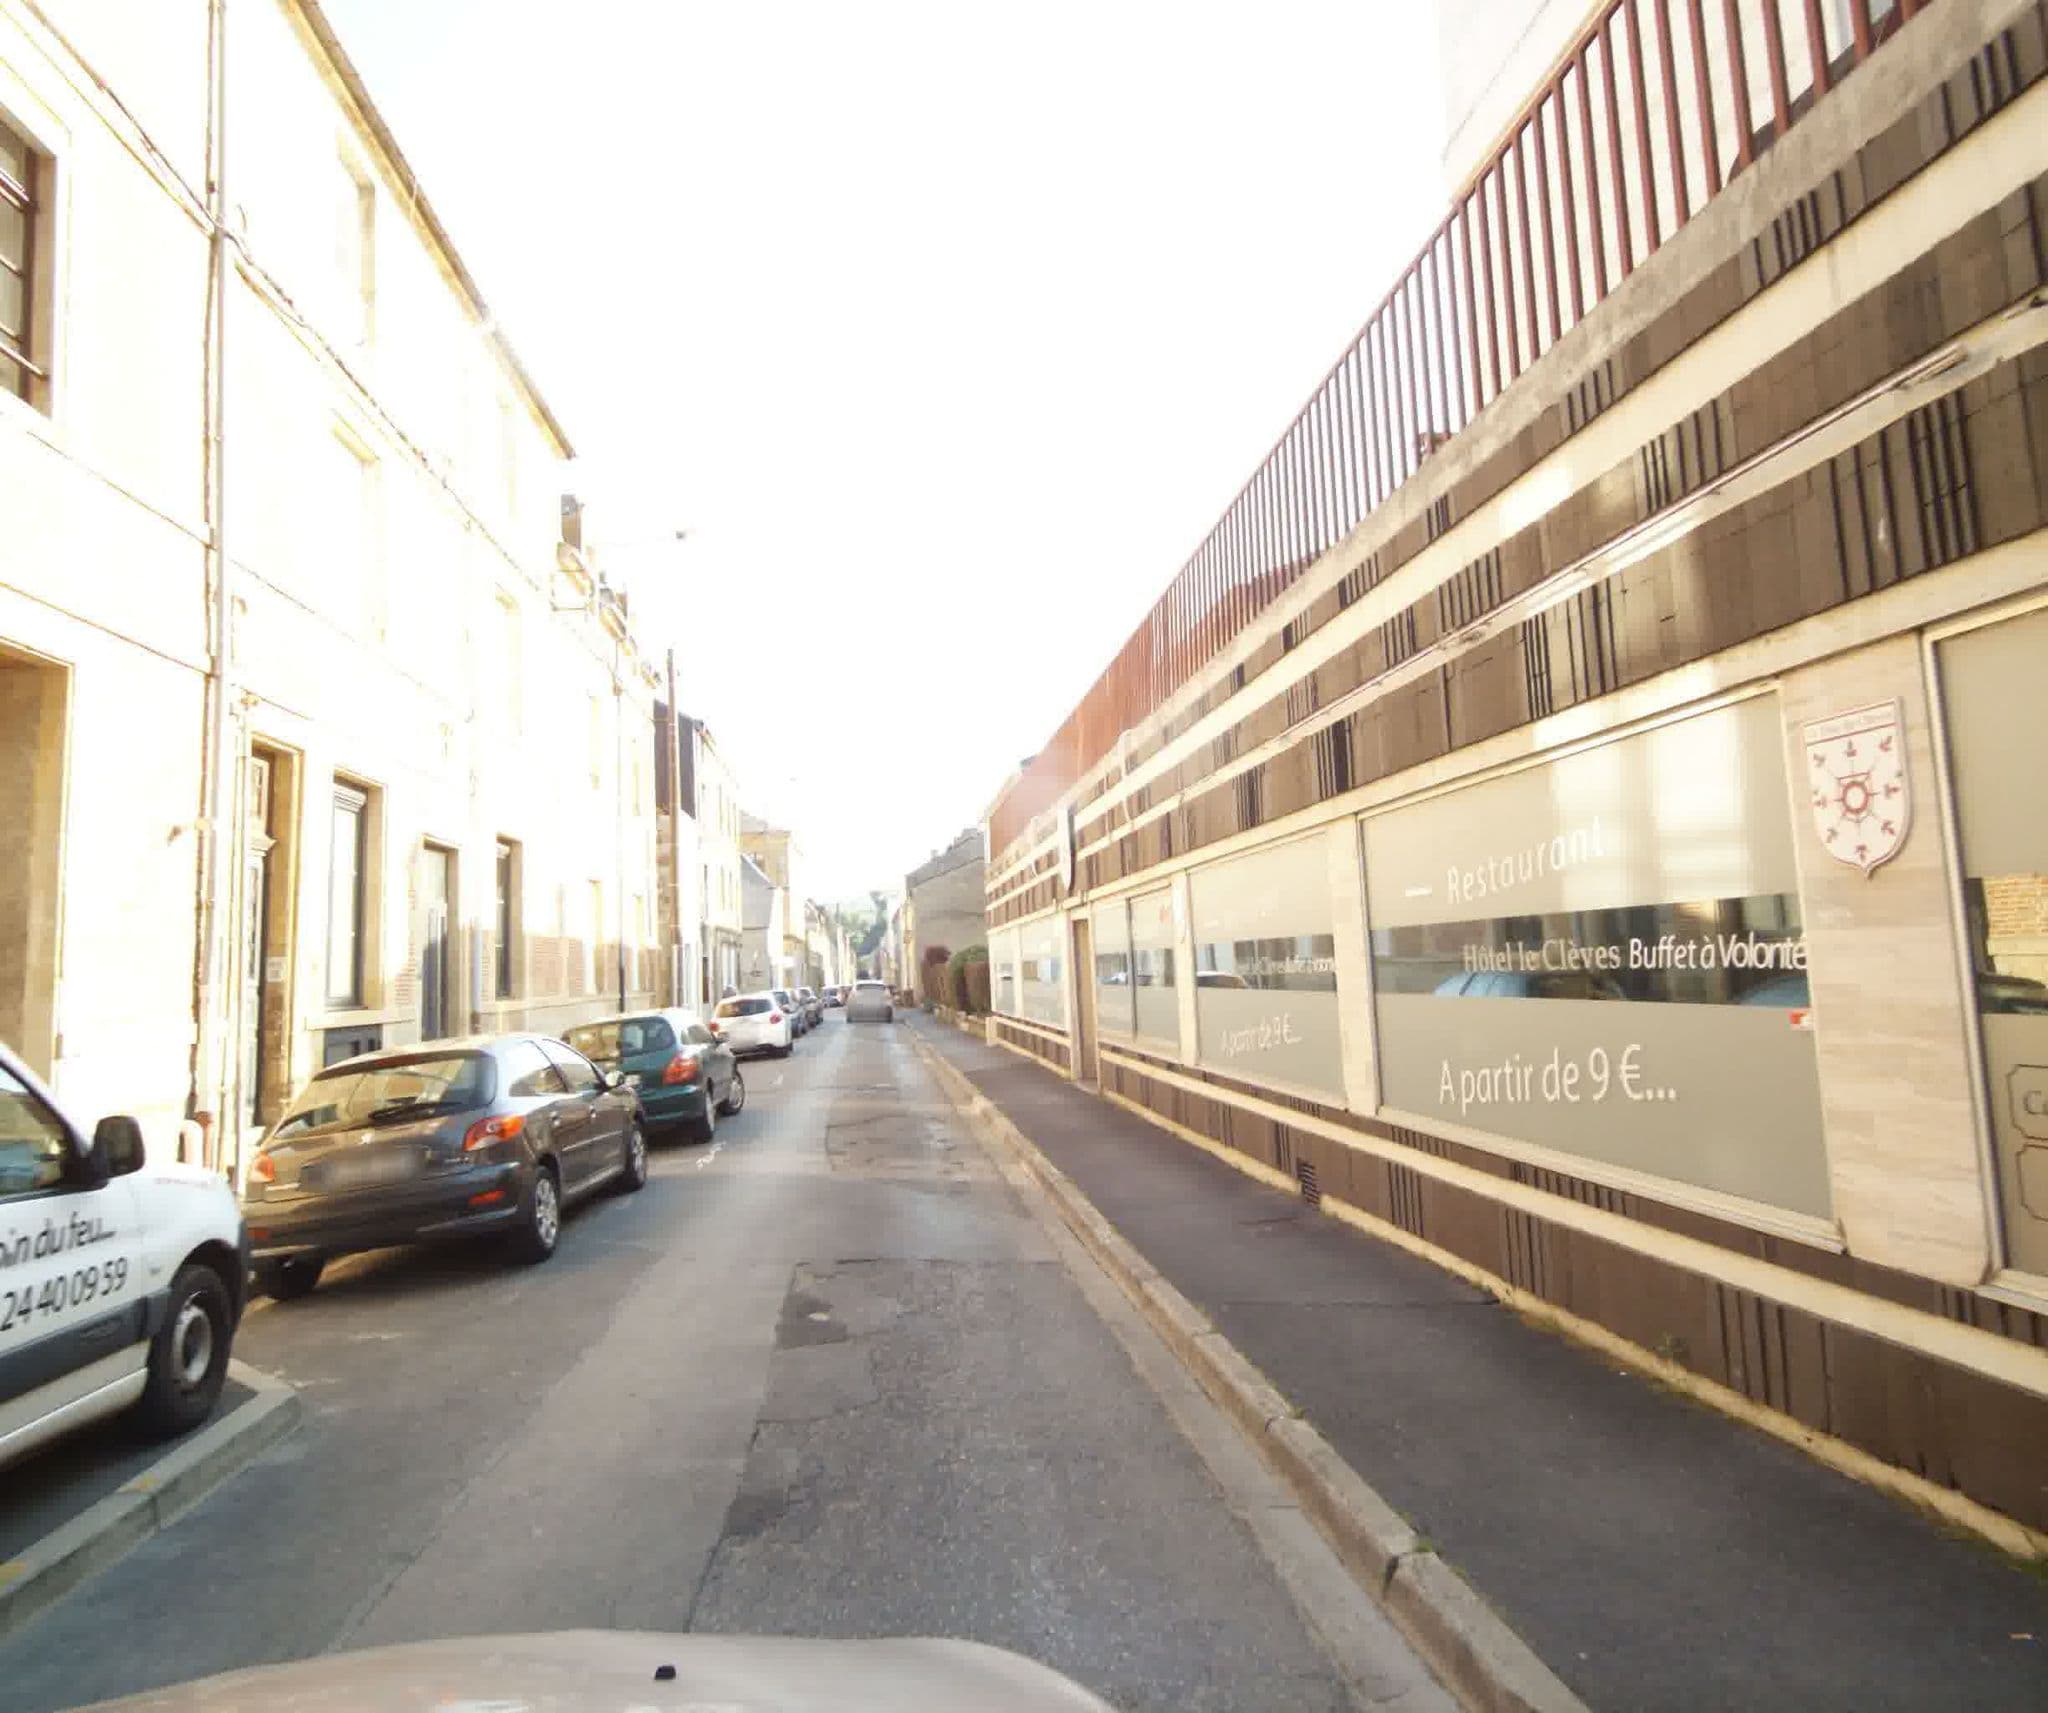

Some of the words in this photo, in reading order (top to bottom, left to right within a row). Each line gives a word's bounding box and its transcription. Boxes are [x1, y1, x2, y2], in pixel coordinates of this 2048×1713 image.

[1447, 815, 1604, 905] Restaurant
[1463, 941, 1513, 973] Hôtel
[1542, 938, 1621, 971] Clèves
[1629, 934, 1697, 970] Buffet
[1700, 936, 1716, 970] à
[1717, 930, 1808, 971] Volonté
[1439, 1059, 1455, 1104] A
[1461, 1053, 1534, 1117] partir
[1542, 1047, 1580, 1102] de
[1589, 1047, 1610, 1100] 9
